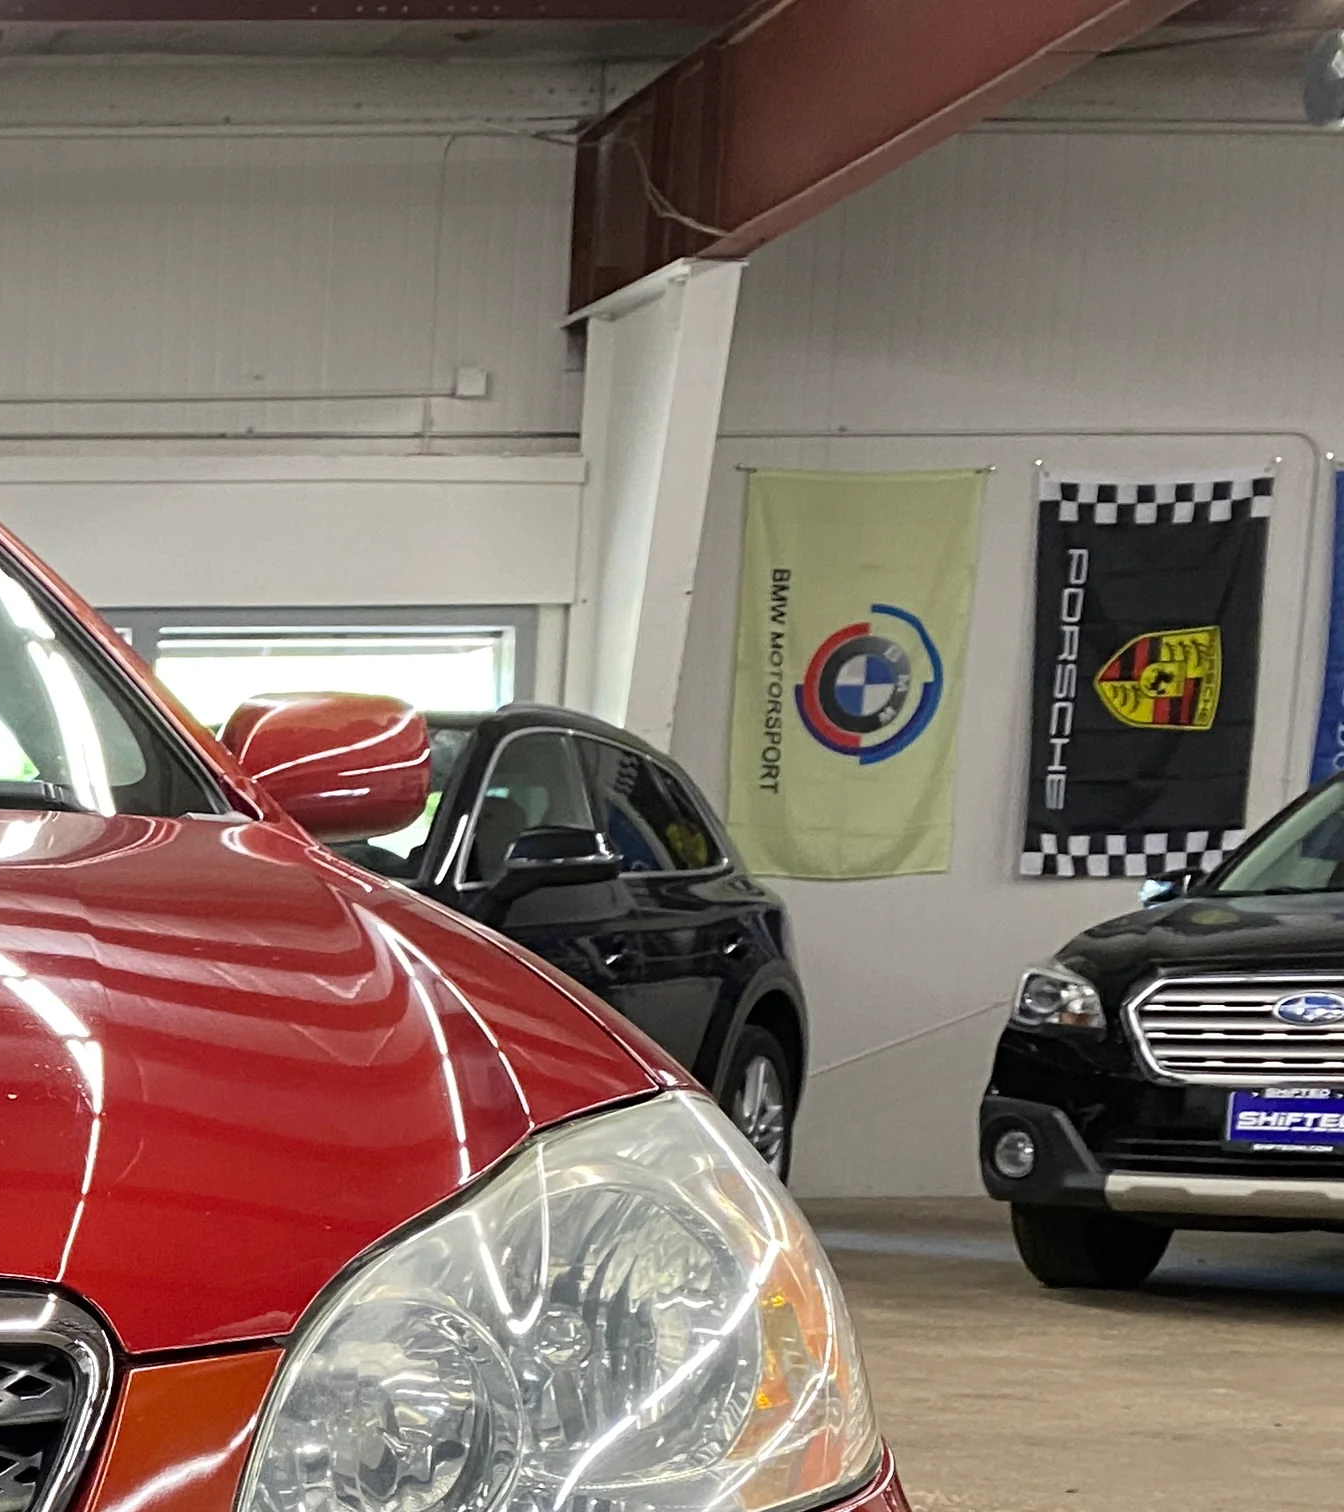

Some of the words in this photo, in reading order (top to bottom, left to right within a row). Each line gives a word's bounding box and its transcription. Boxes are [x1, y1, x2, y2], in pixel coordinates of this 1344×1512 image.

[768, 568, 792, 626] BMW
[1045, 548, 1089, 810] PORSCHE
[759, 631, 786, 795] MOTORSPORT
